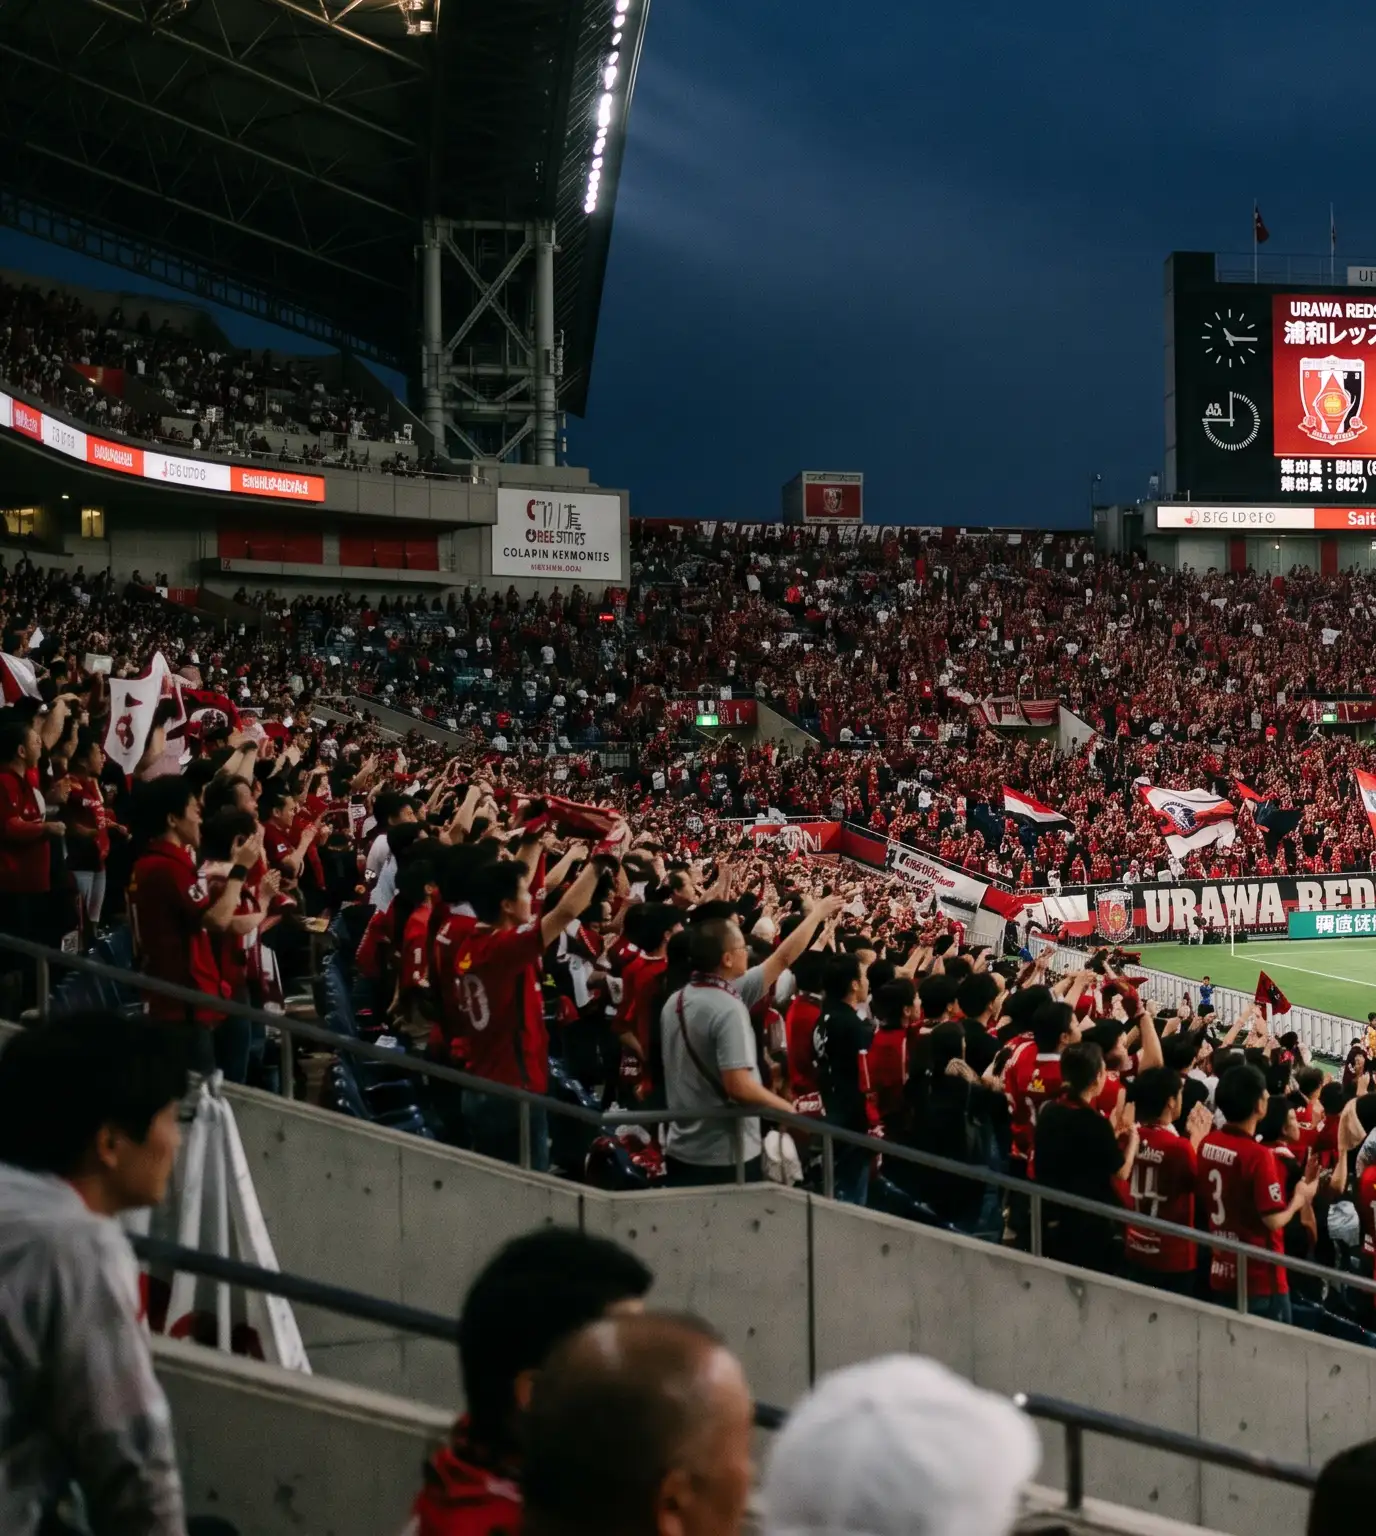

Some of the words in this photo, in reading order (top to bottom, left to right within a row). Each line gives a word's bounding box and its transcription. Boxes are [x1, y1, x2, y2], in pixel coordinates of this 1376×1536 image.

[1290, 302, 1342, 318] URAWA
[1143, 882, 1286, 933] URAWA
[1208, 1168, 1226, 1226] 3
